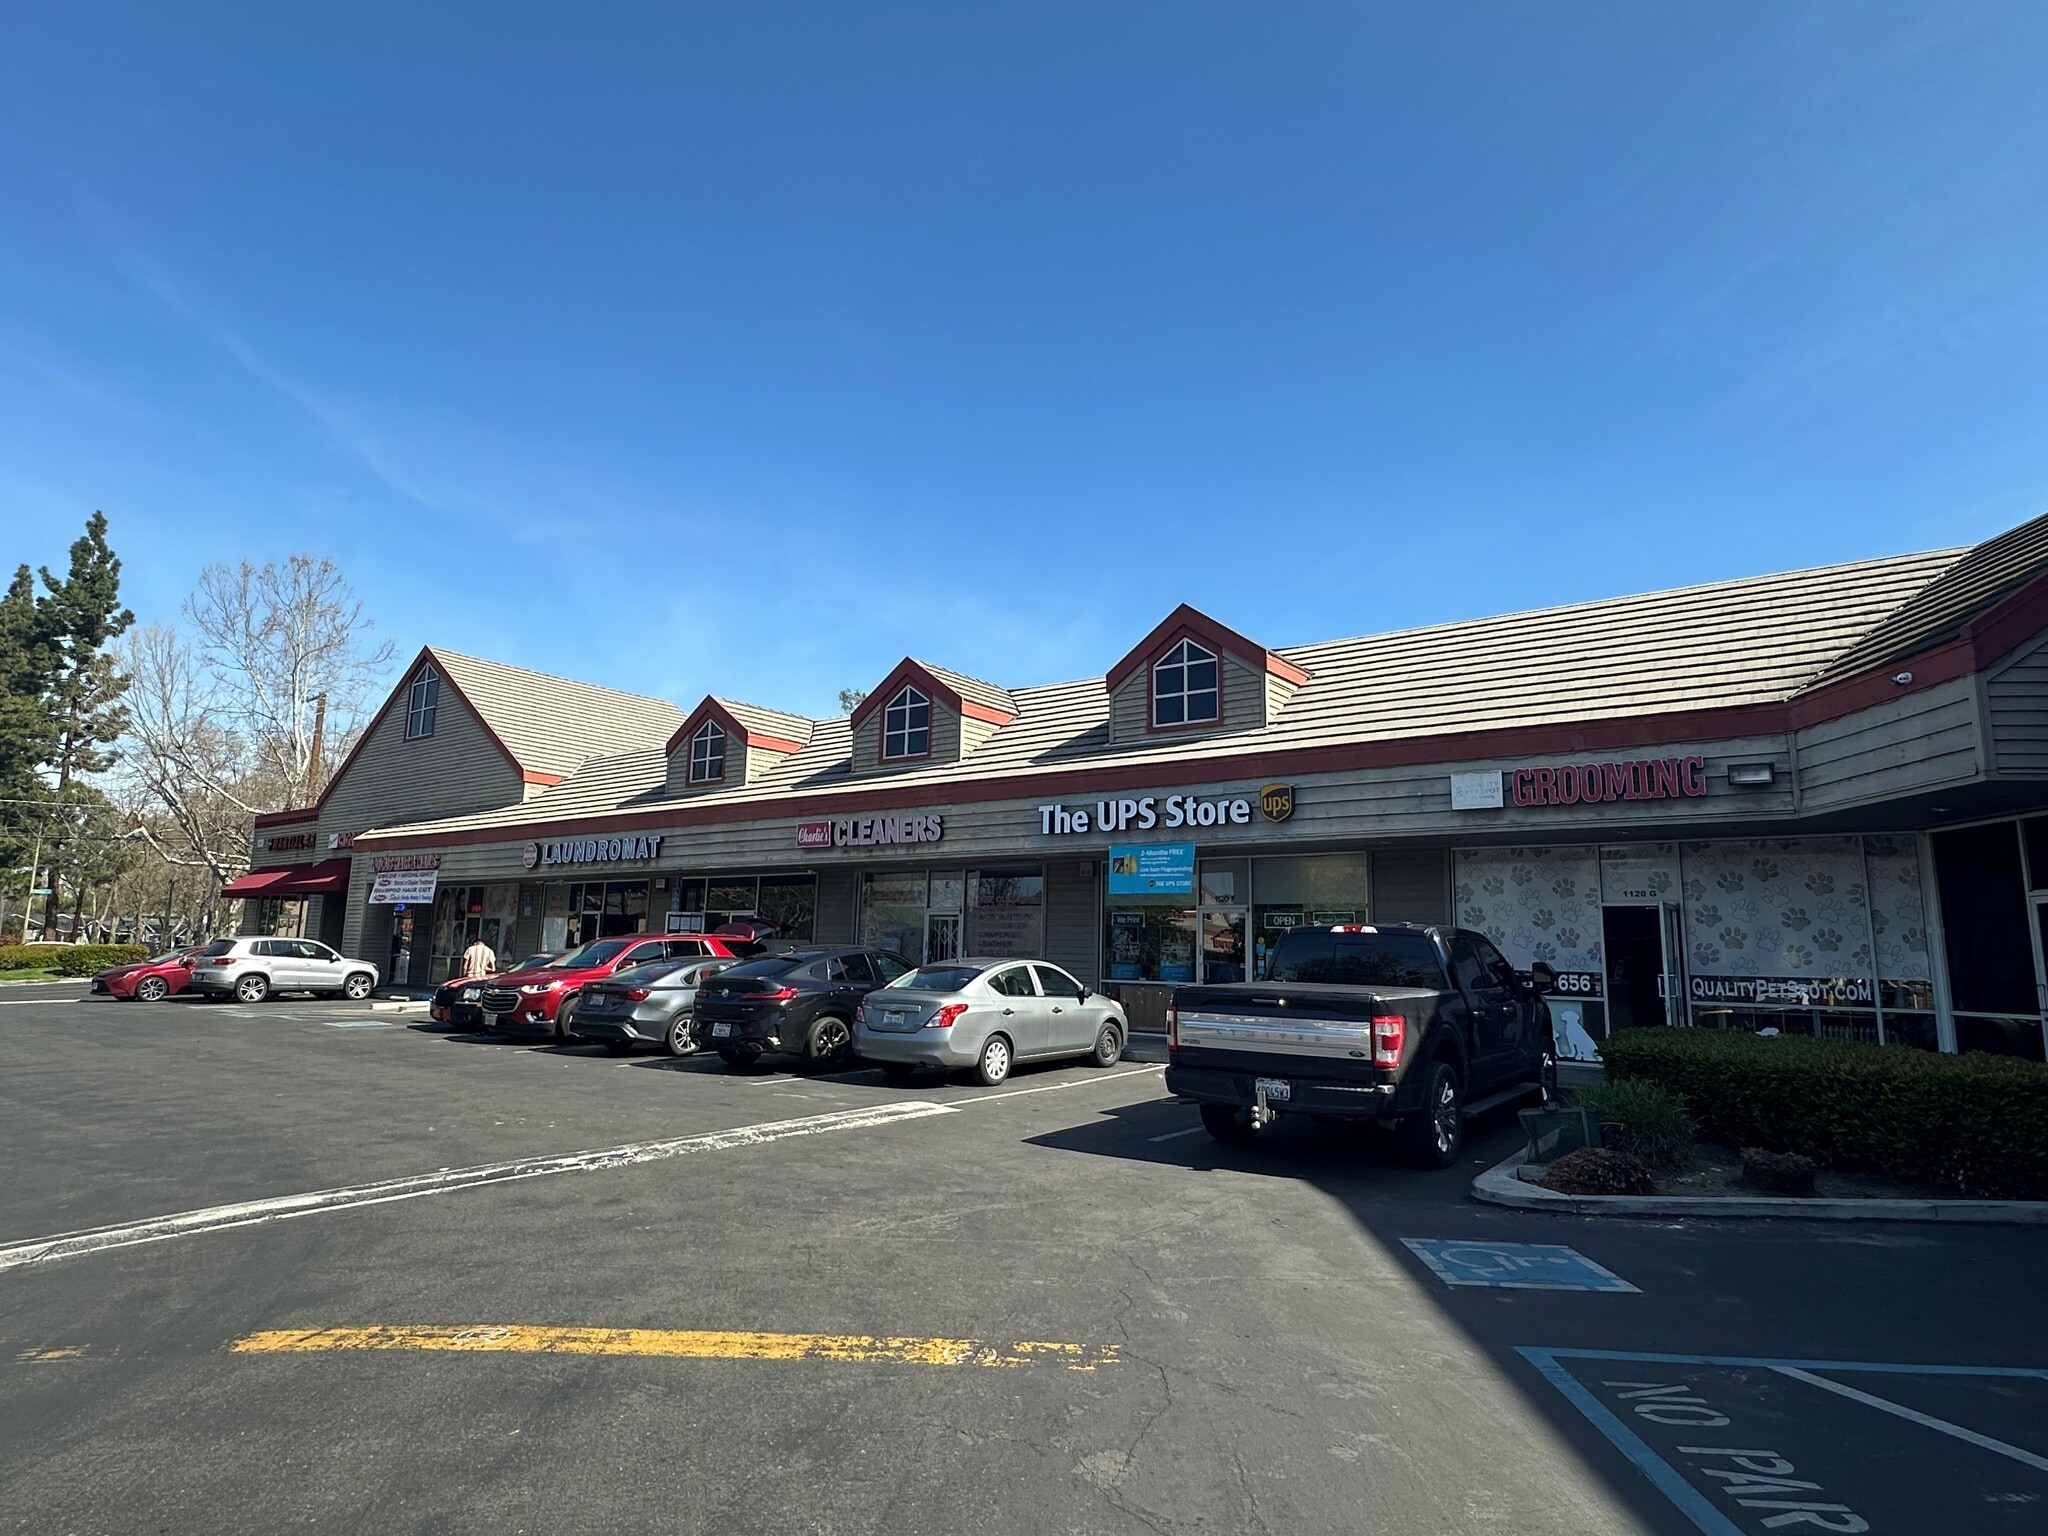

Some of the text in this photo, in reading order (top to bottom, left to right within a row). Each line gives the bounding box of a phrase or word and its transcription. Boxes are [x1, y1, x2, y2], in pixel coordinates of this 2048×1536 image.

[1512, 755, 1707, 807] GROOMING
[1038, 795, 1250, 834] The UPS Store
[1263, 795, 1290, 817] ups
[798, 827, 829, 844] Charlie's
[834, 815, 942, 847] CLEANERS
[542, 836, 661, 864] LAUNDROMAT
[1623, 890, 1646, 898] 1120
[1273, 916, 1296, 925] OPEN
[1600, 1380, 1731, 1427] NO
